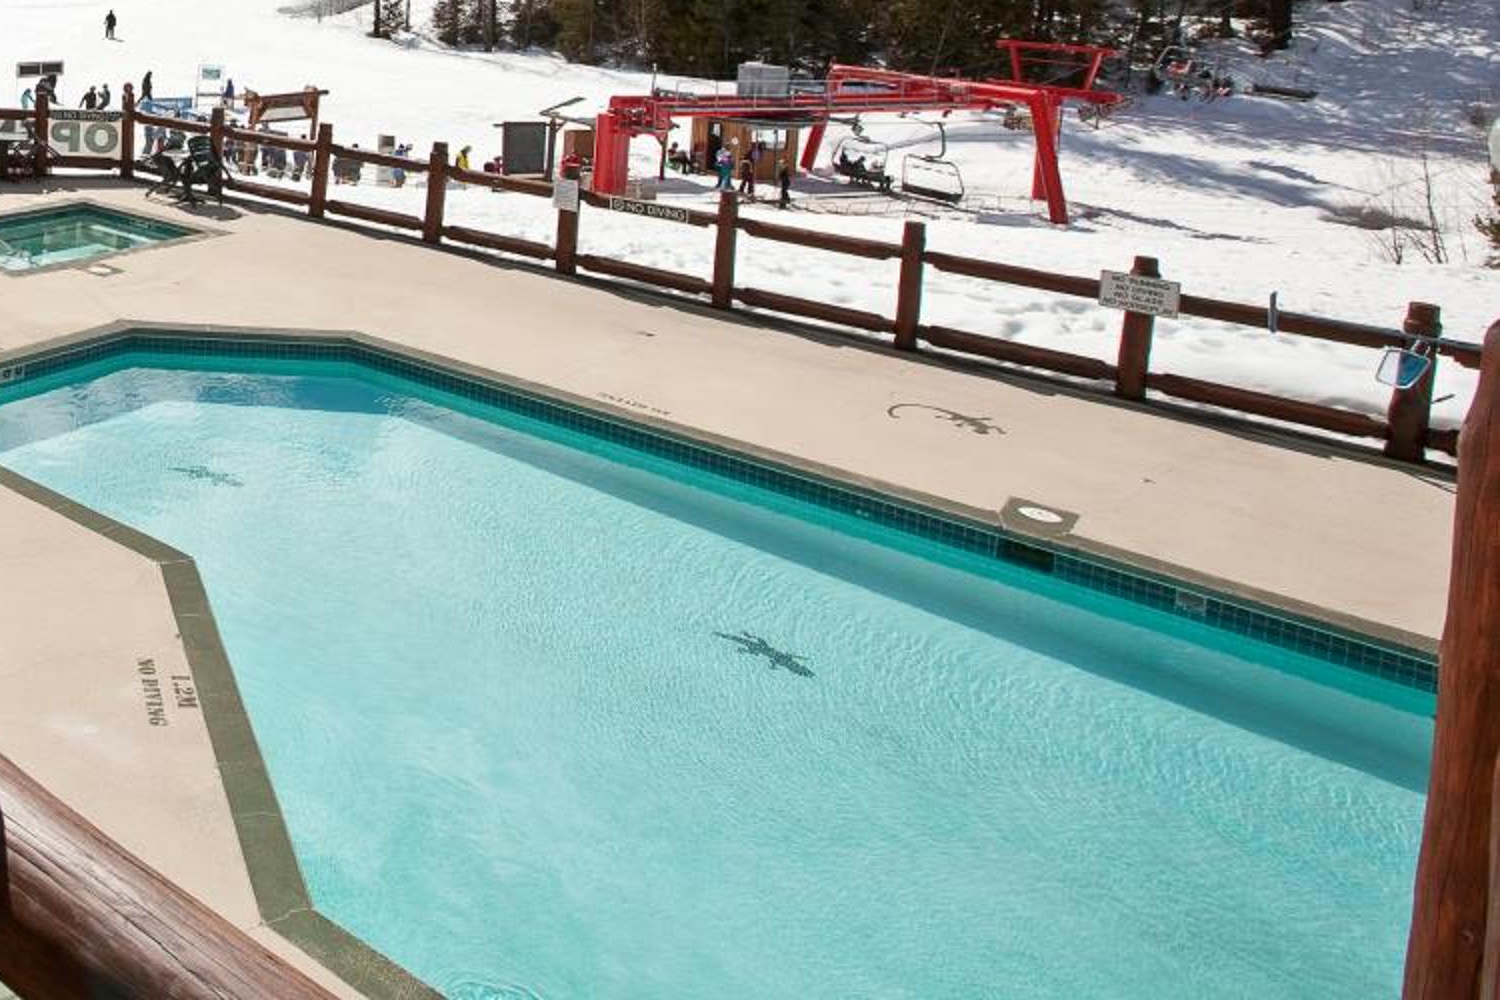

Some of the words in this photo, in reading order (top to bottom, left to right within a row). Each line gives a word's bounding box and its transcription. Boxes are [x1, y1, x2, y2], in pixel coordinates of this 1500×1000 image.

[626, 202, 645, 213] NO
[647, 205, 685, 221] DIVING
[137, 658, 157, 676] NO
[141, 678, 169, 727] DIVING
